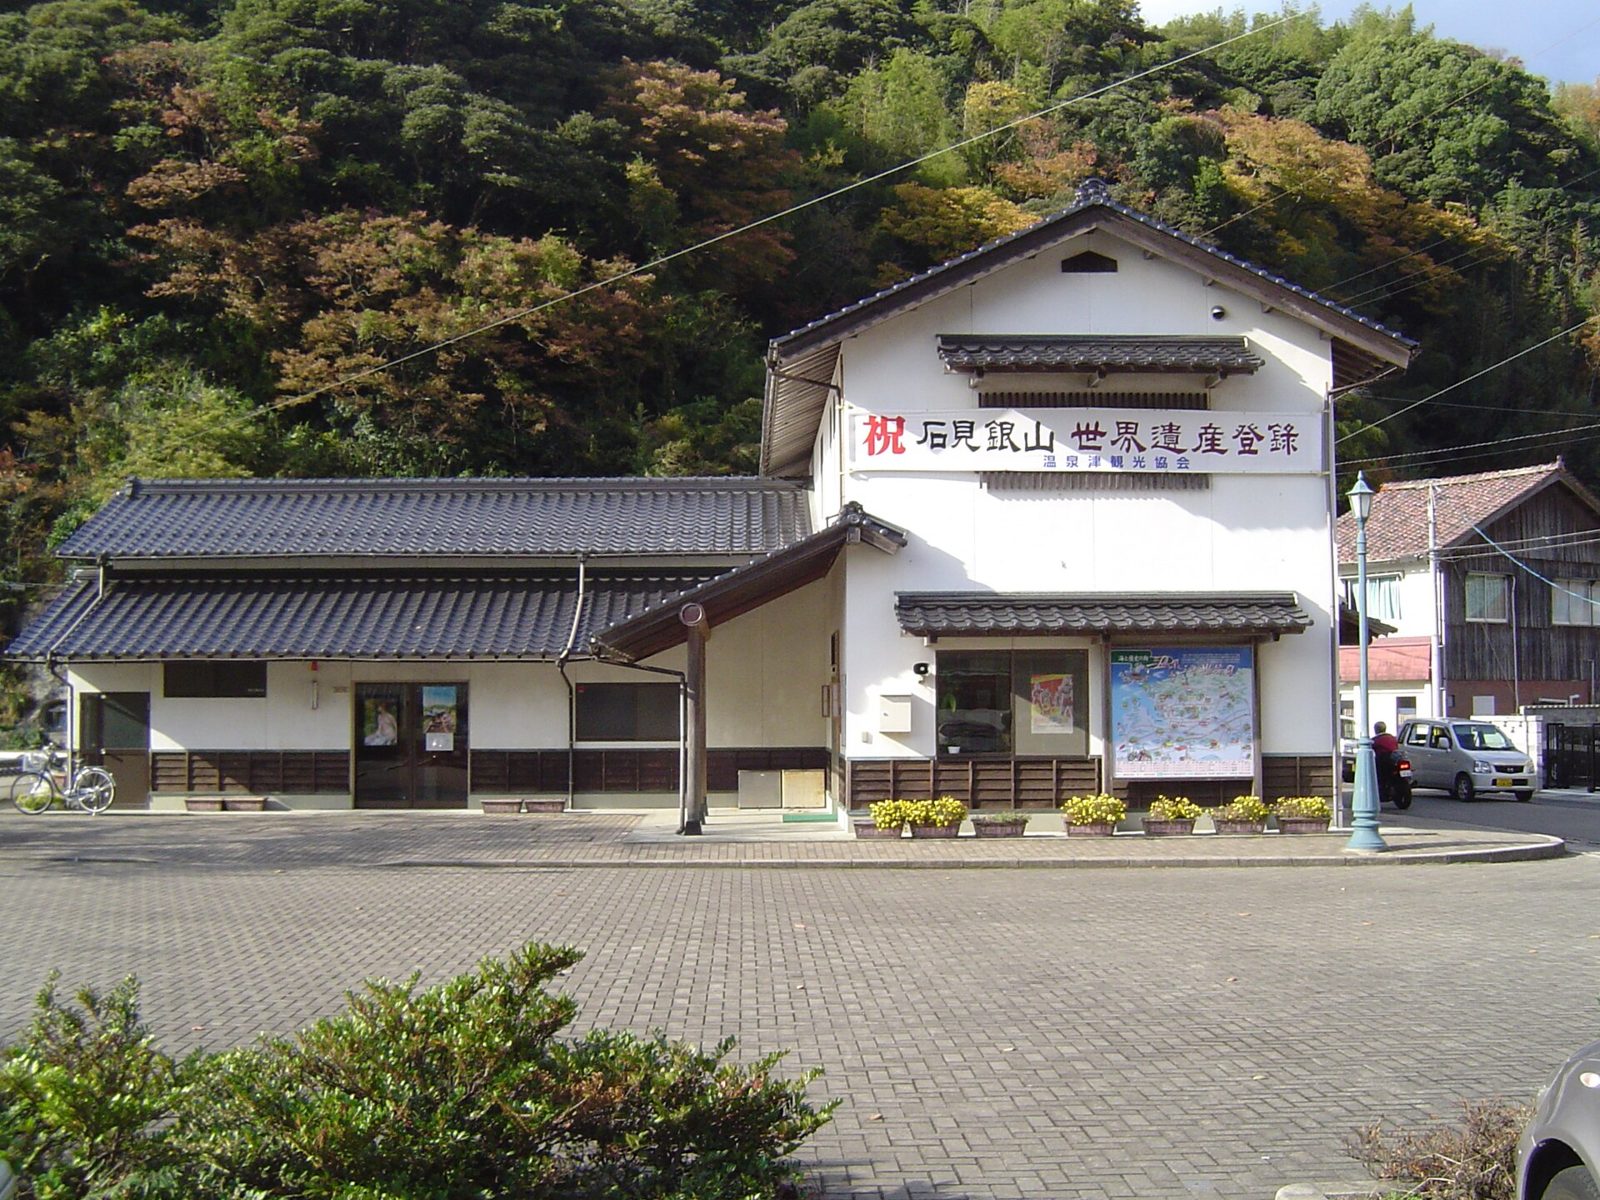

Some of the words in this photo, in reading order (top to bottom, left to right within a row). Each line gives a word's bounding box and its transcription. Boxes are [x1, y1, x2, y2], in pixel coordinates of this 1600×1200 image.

[862, 415, 906, 456] 祝
[916, 419, 1055, 453] 石見銀山
[1043, 454, 1190, 470] 温泉津観光協会
